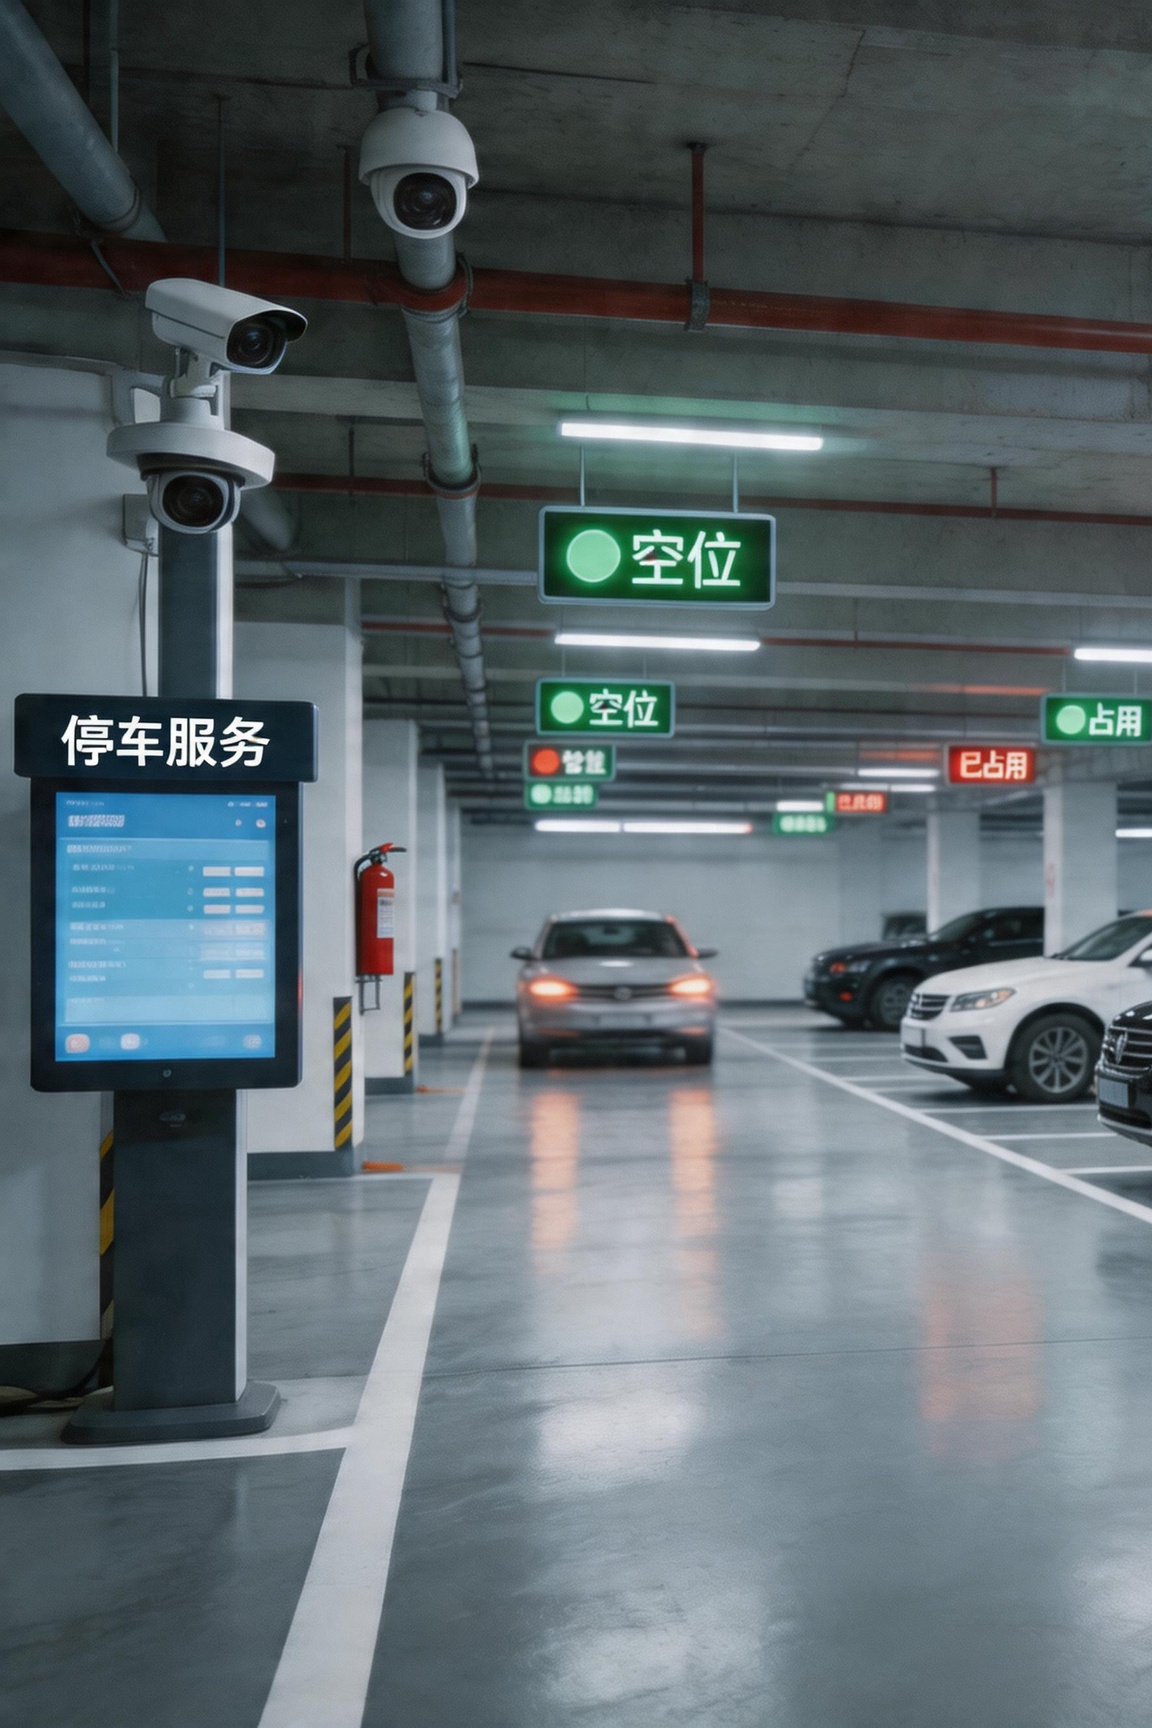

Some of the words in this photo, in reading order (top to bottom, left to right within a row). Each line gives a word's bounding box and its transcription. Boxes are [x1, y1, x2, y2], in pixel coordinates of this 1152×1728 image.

[632, 529, 741, 589] 空位
[589, 688, 659, 728] 空位
[1089, 703, 1141, 737] 占用
[60, 714, 270, 768] 停车服务
